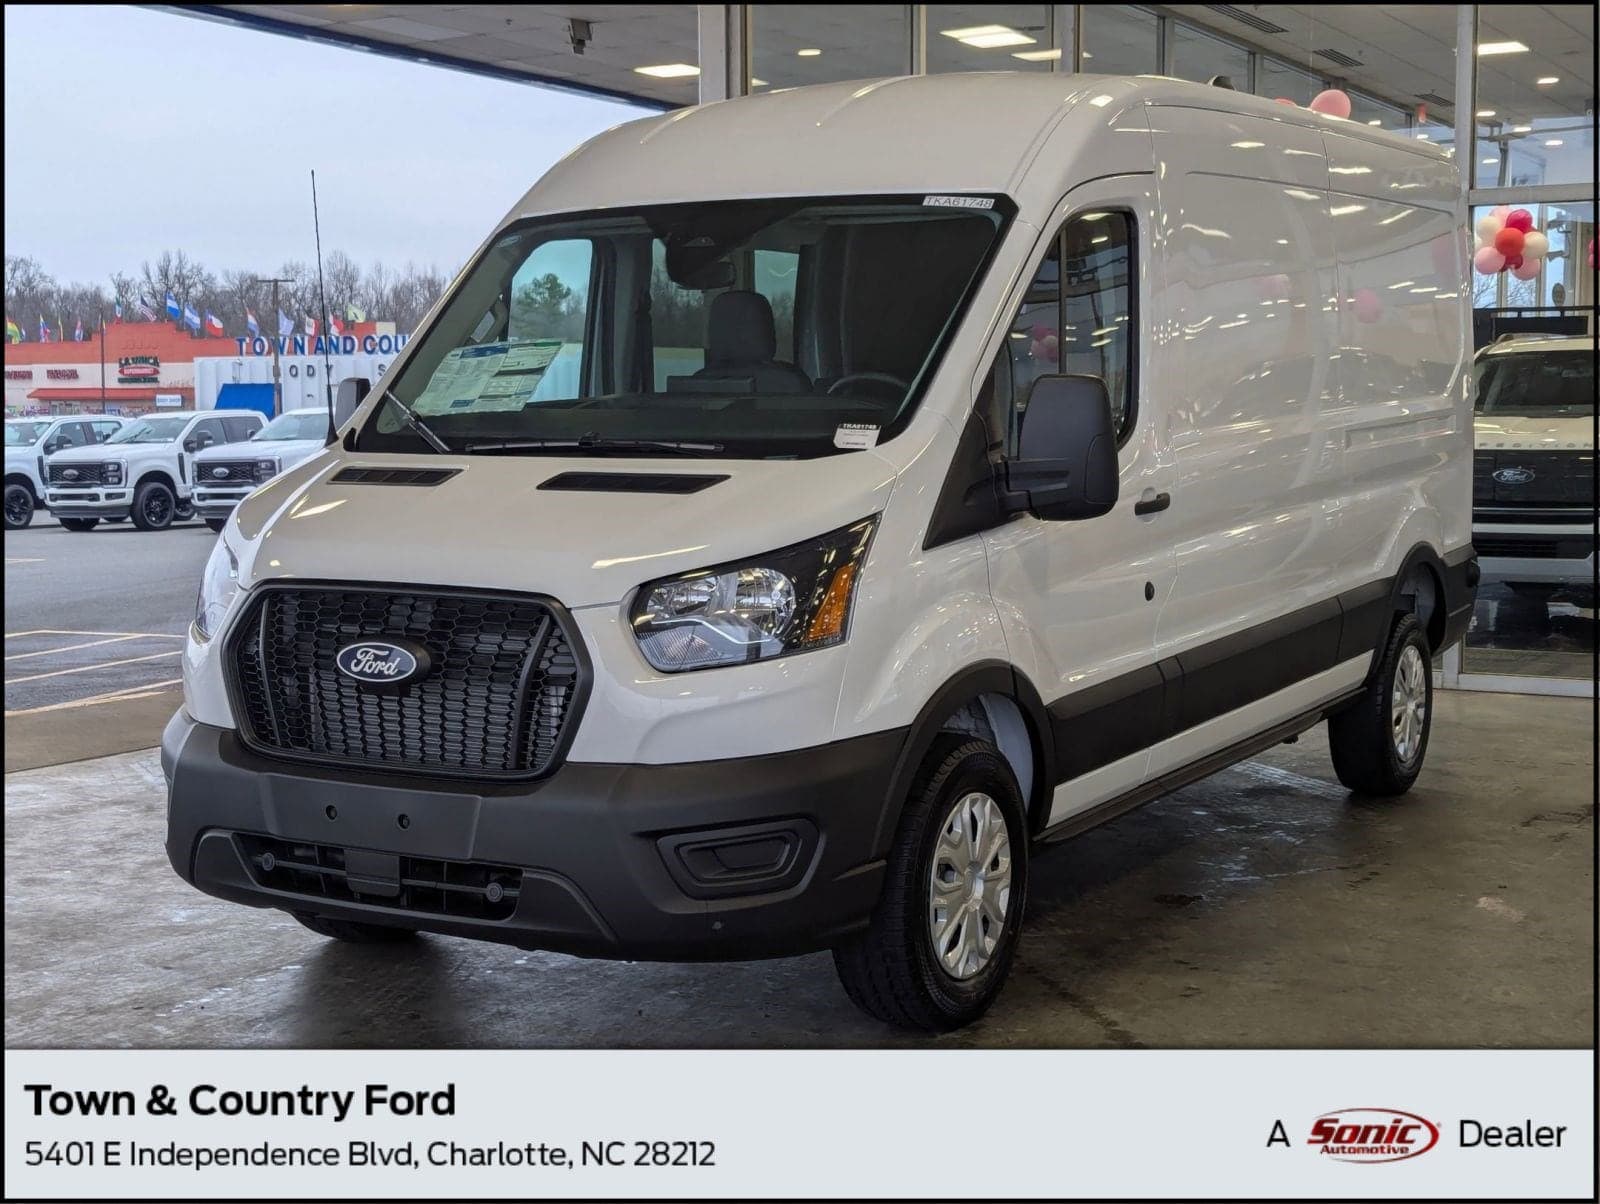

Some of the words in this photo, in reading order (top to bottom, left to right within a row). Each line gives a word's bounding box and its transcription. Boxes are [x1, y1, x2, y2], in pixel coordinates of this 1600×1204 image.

[924, 196, 993, 209] TKA61748
[234, 335, 306, 356] TOWN
[314, 335, 356, 355] AND
[1500, 470, 1528, 481] Ford
[351, 648, 400, 675] Ford
